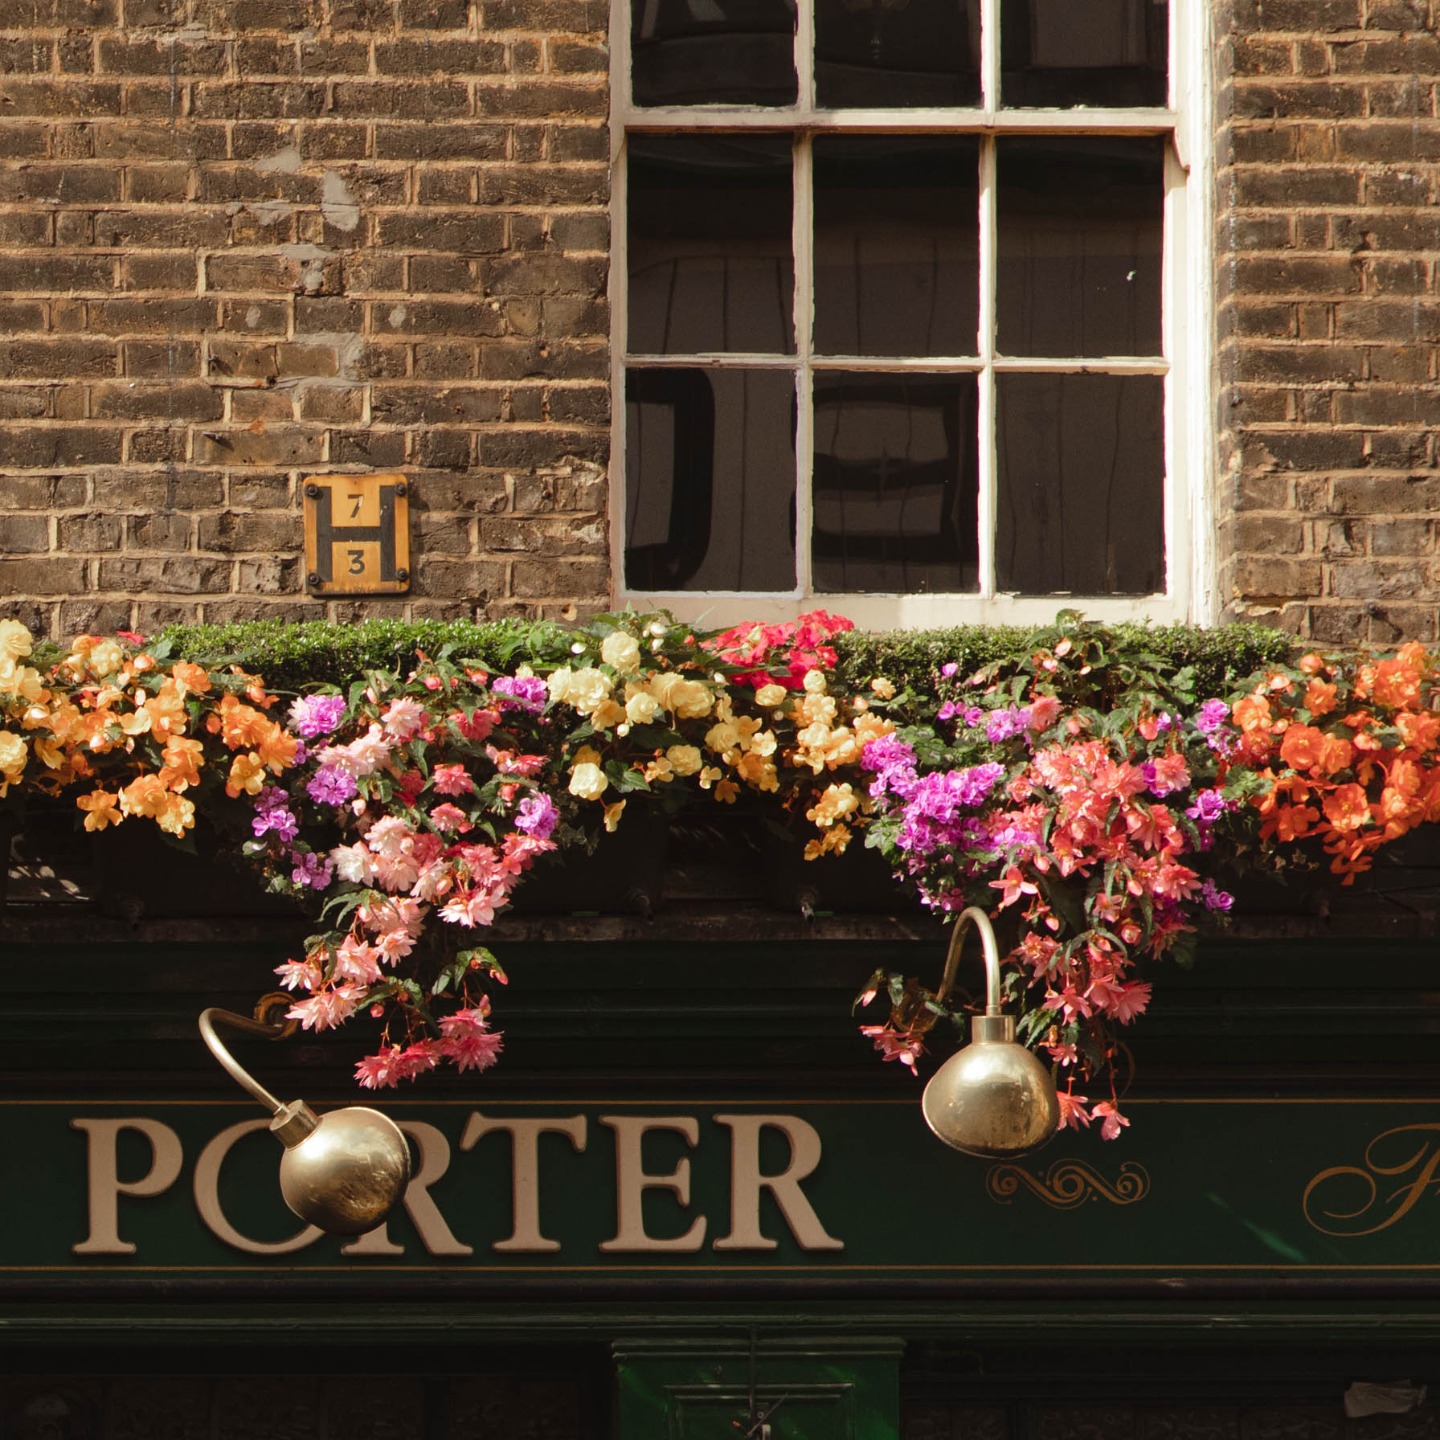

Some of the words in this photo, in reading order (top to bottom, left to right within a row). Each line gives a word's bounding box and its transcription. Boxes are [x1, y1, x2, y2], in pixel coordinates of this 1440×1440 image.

[316, 485, 395, 582] H
[347, 494, 364, 519] 7
[347, 549, 365, 575] 3
[69, 1110, 845, 1257] PORTER
